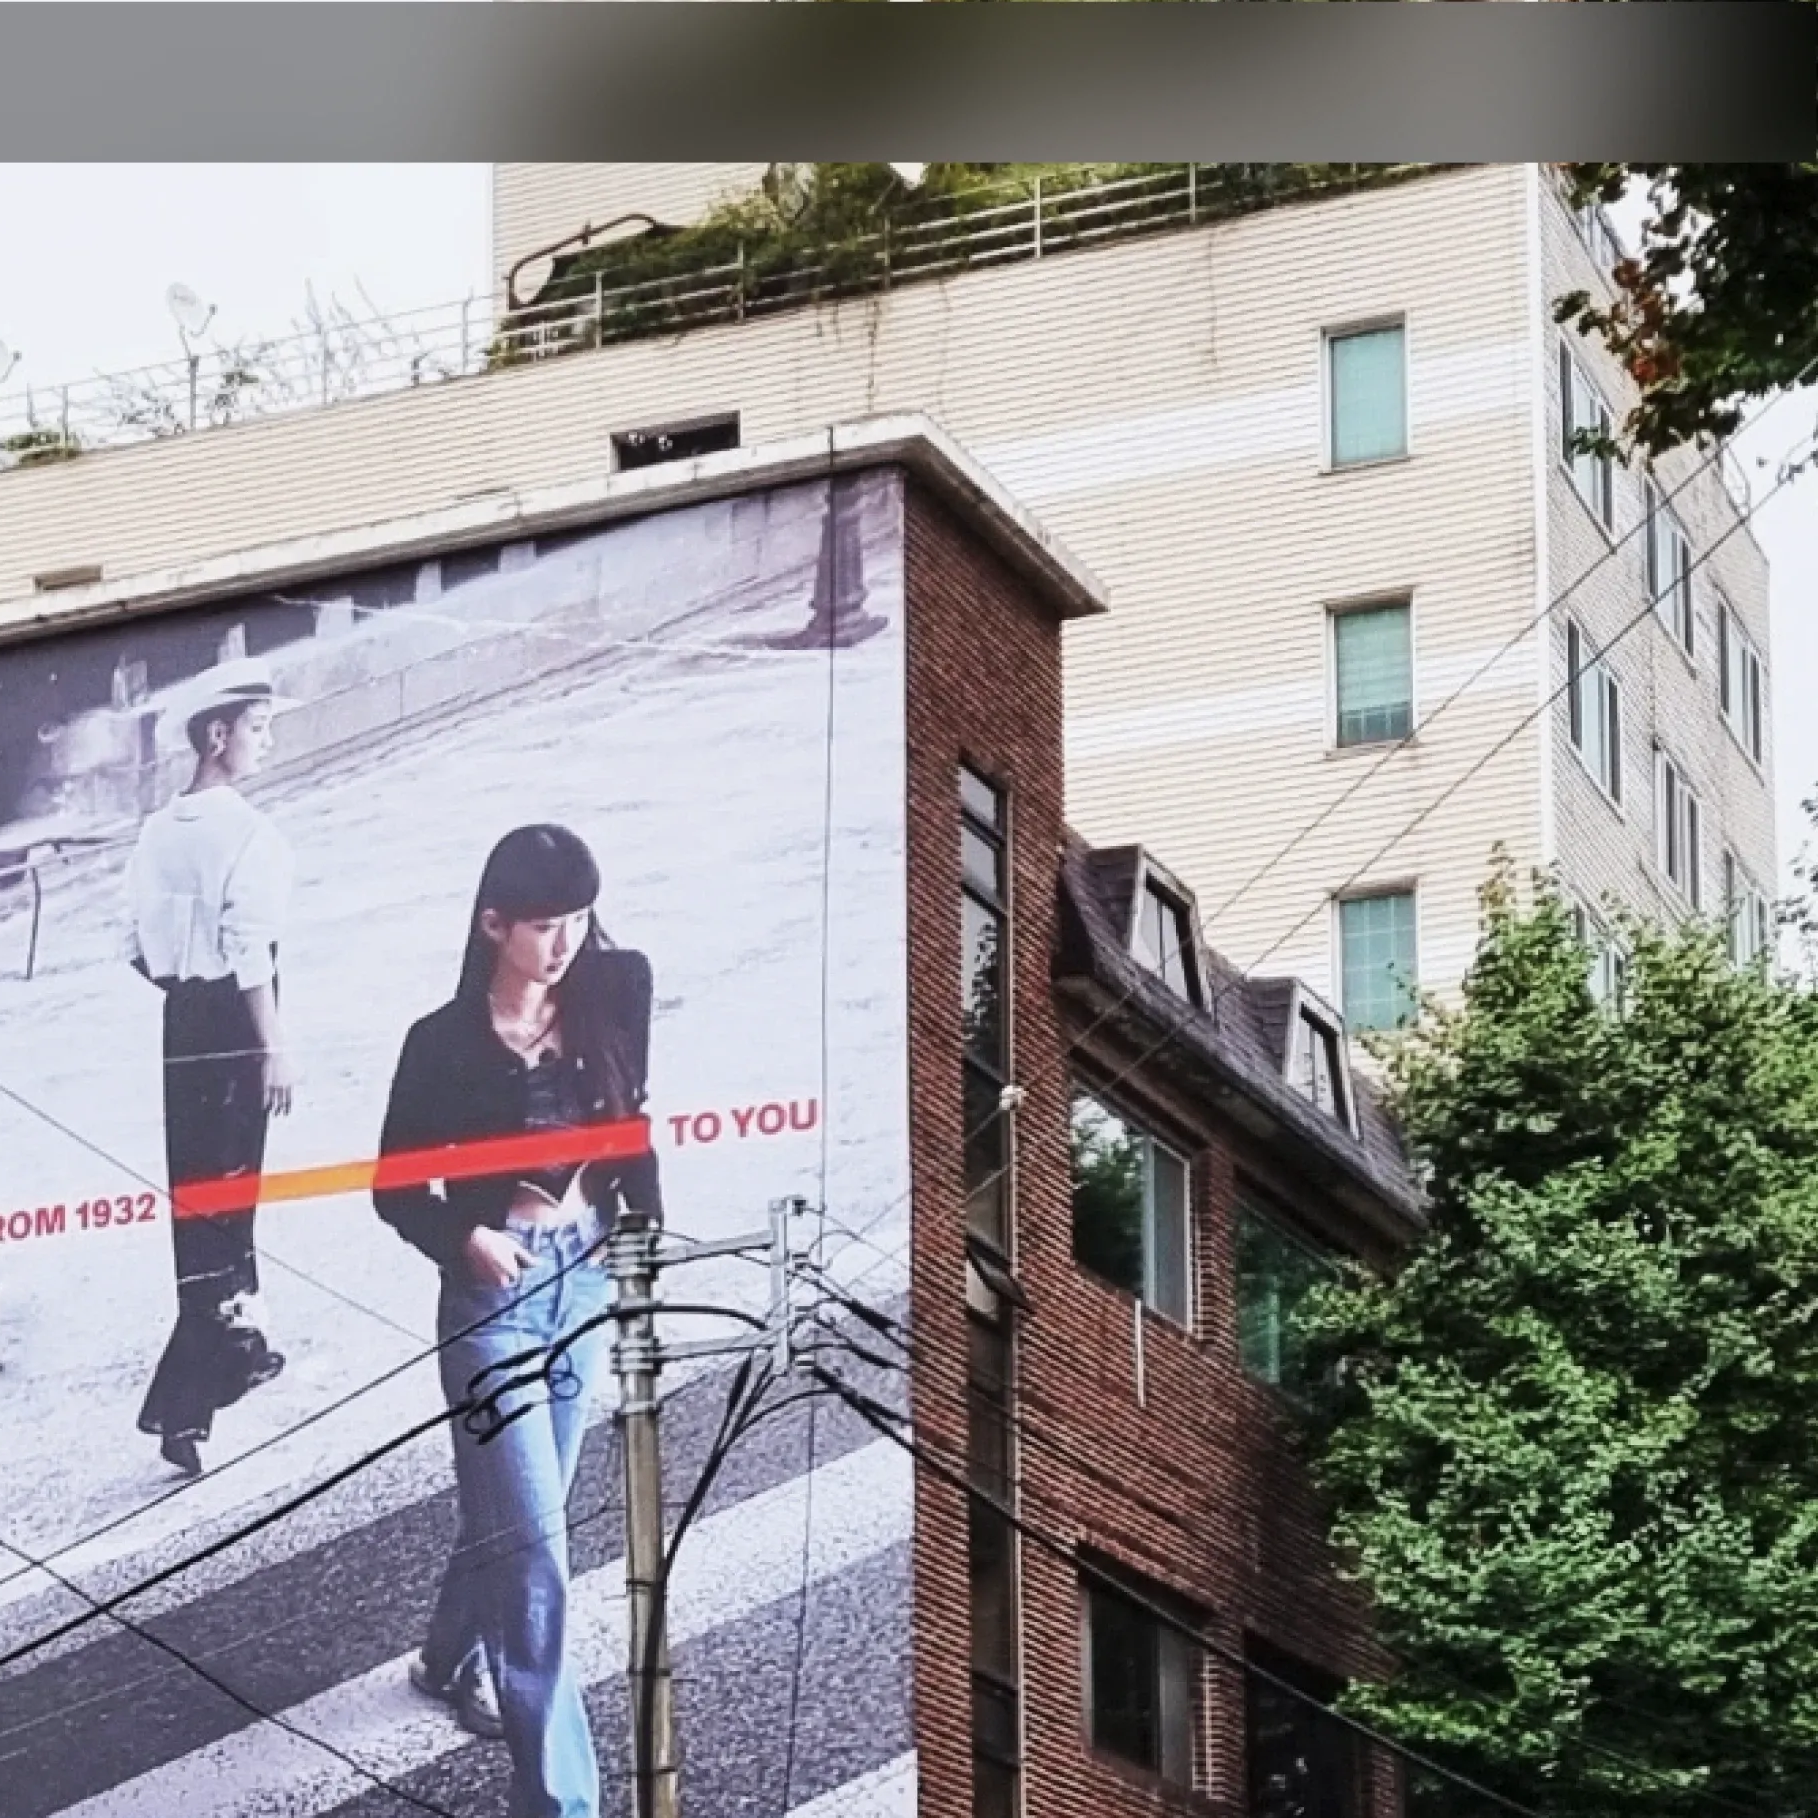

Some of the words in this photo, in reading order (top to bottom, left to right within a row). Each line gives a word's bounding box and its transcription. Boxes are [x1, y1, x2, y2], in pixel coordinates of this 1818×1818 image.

[669, 1112, 720, 1148] TO
[731, 1098, 818, 1140] YOU
[75, 1191, 156, 1231] 1932
